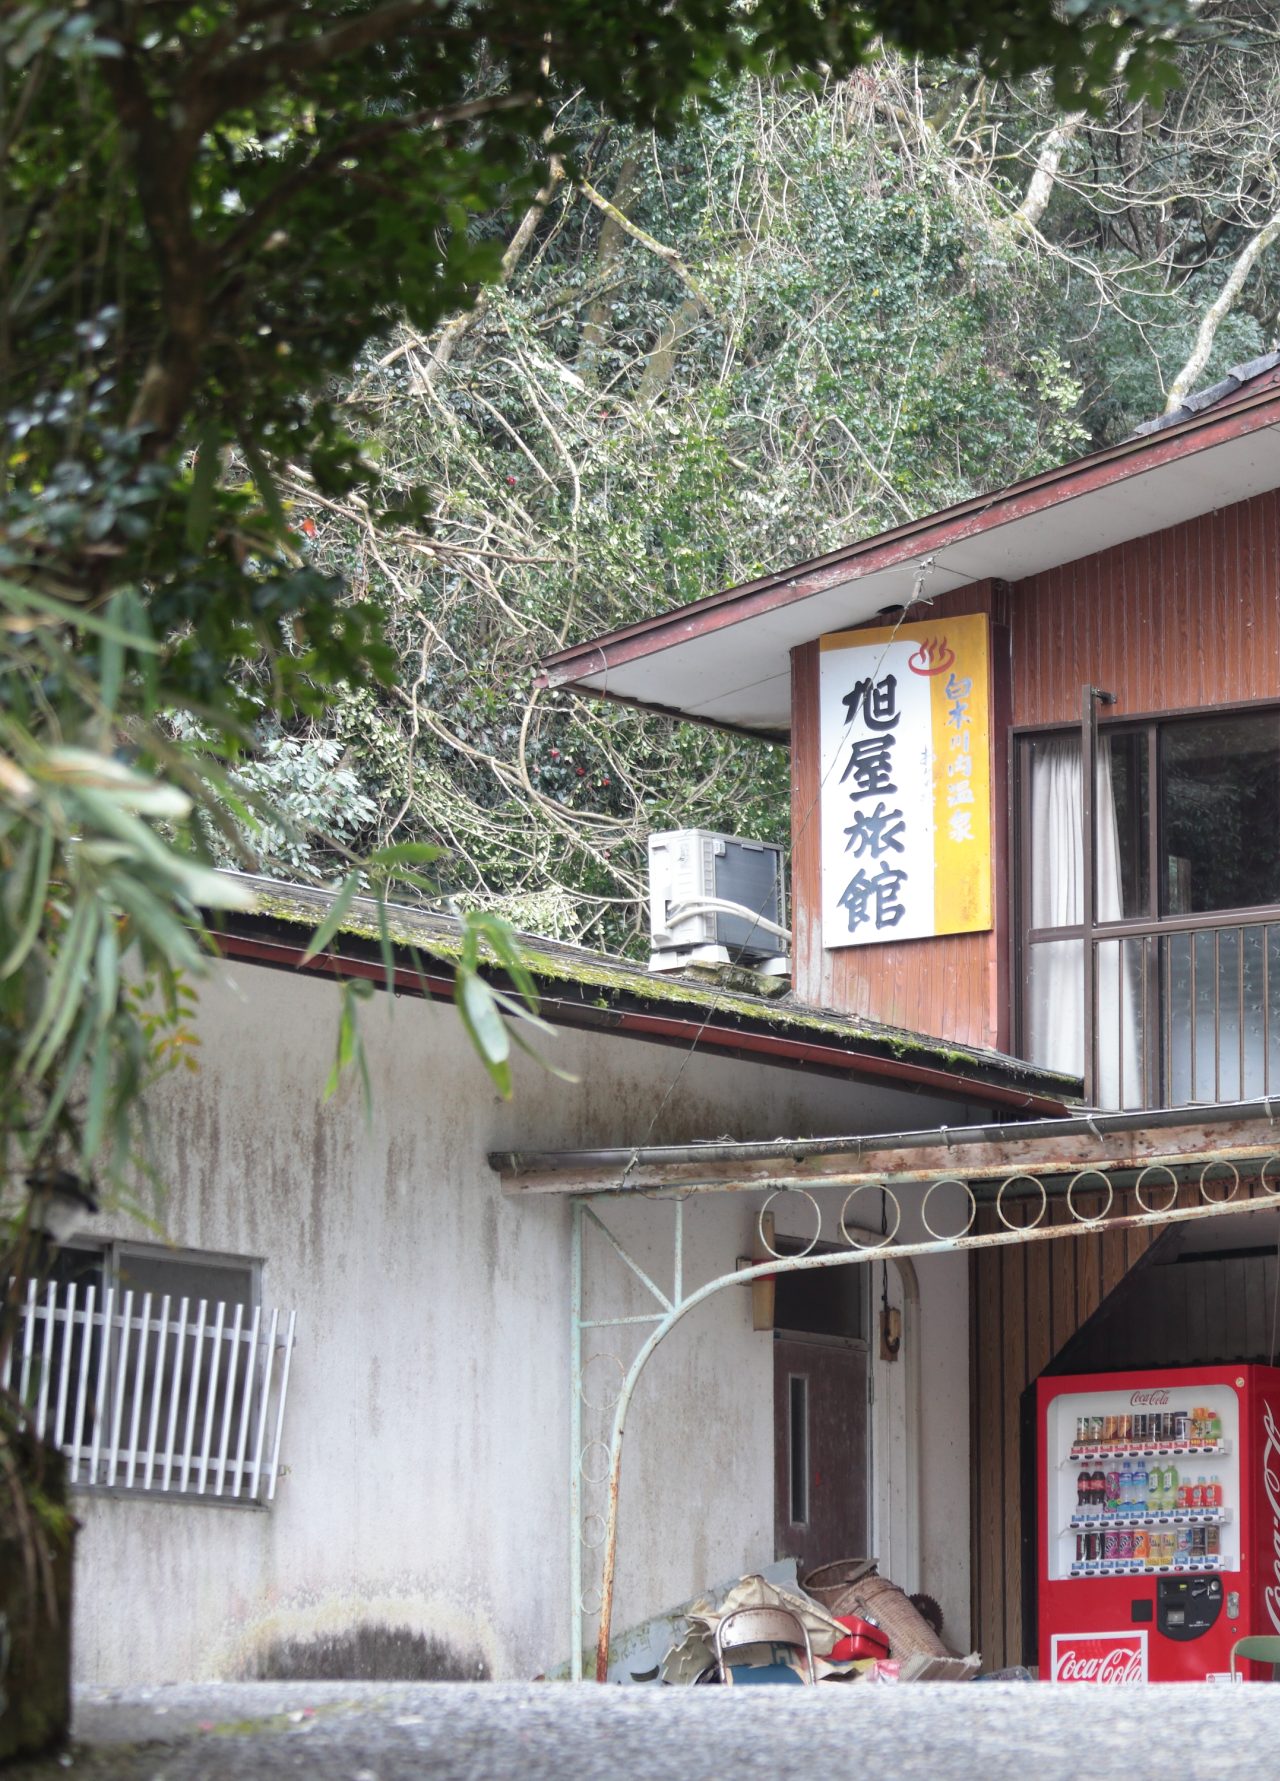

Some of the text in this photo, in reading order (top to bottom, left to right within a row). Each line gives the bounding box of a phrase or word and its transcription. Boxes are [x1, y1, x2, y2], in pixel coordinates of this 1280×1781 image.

[837, 673, 908, 933] 旭屋旅館
[946, 673, 975, 843] 白木川内温泉
[1130, 1389, 1172, 1406] Coca-Cola
[1057, 1648, 1142, 1685] Coca-Cola
